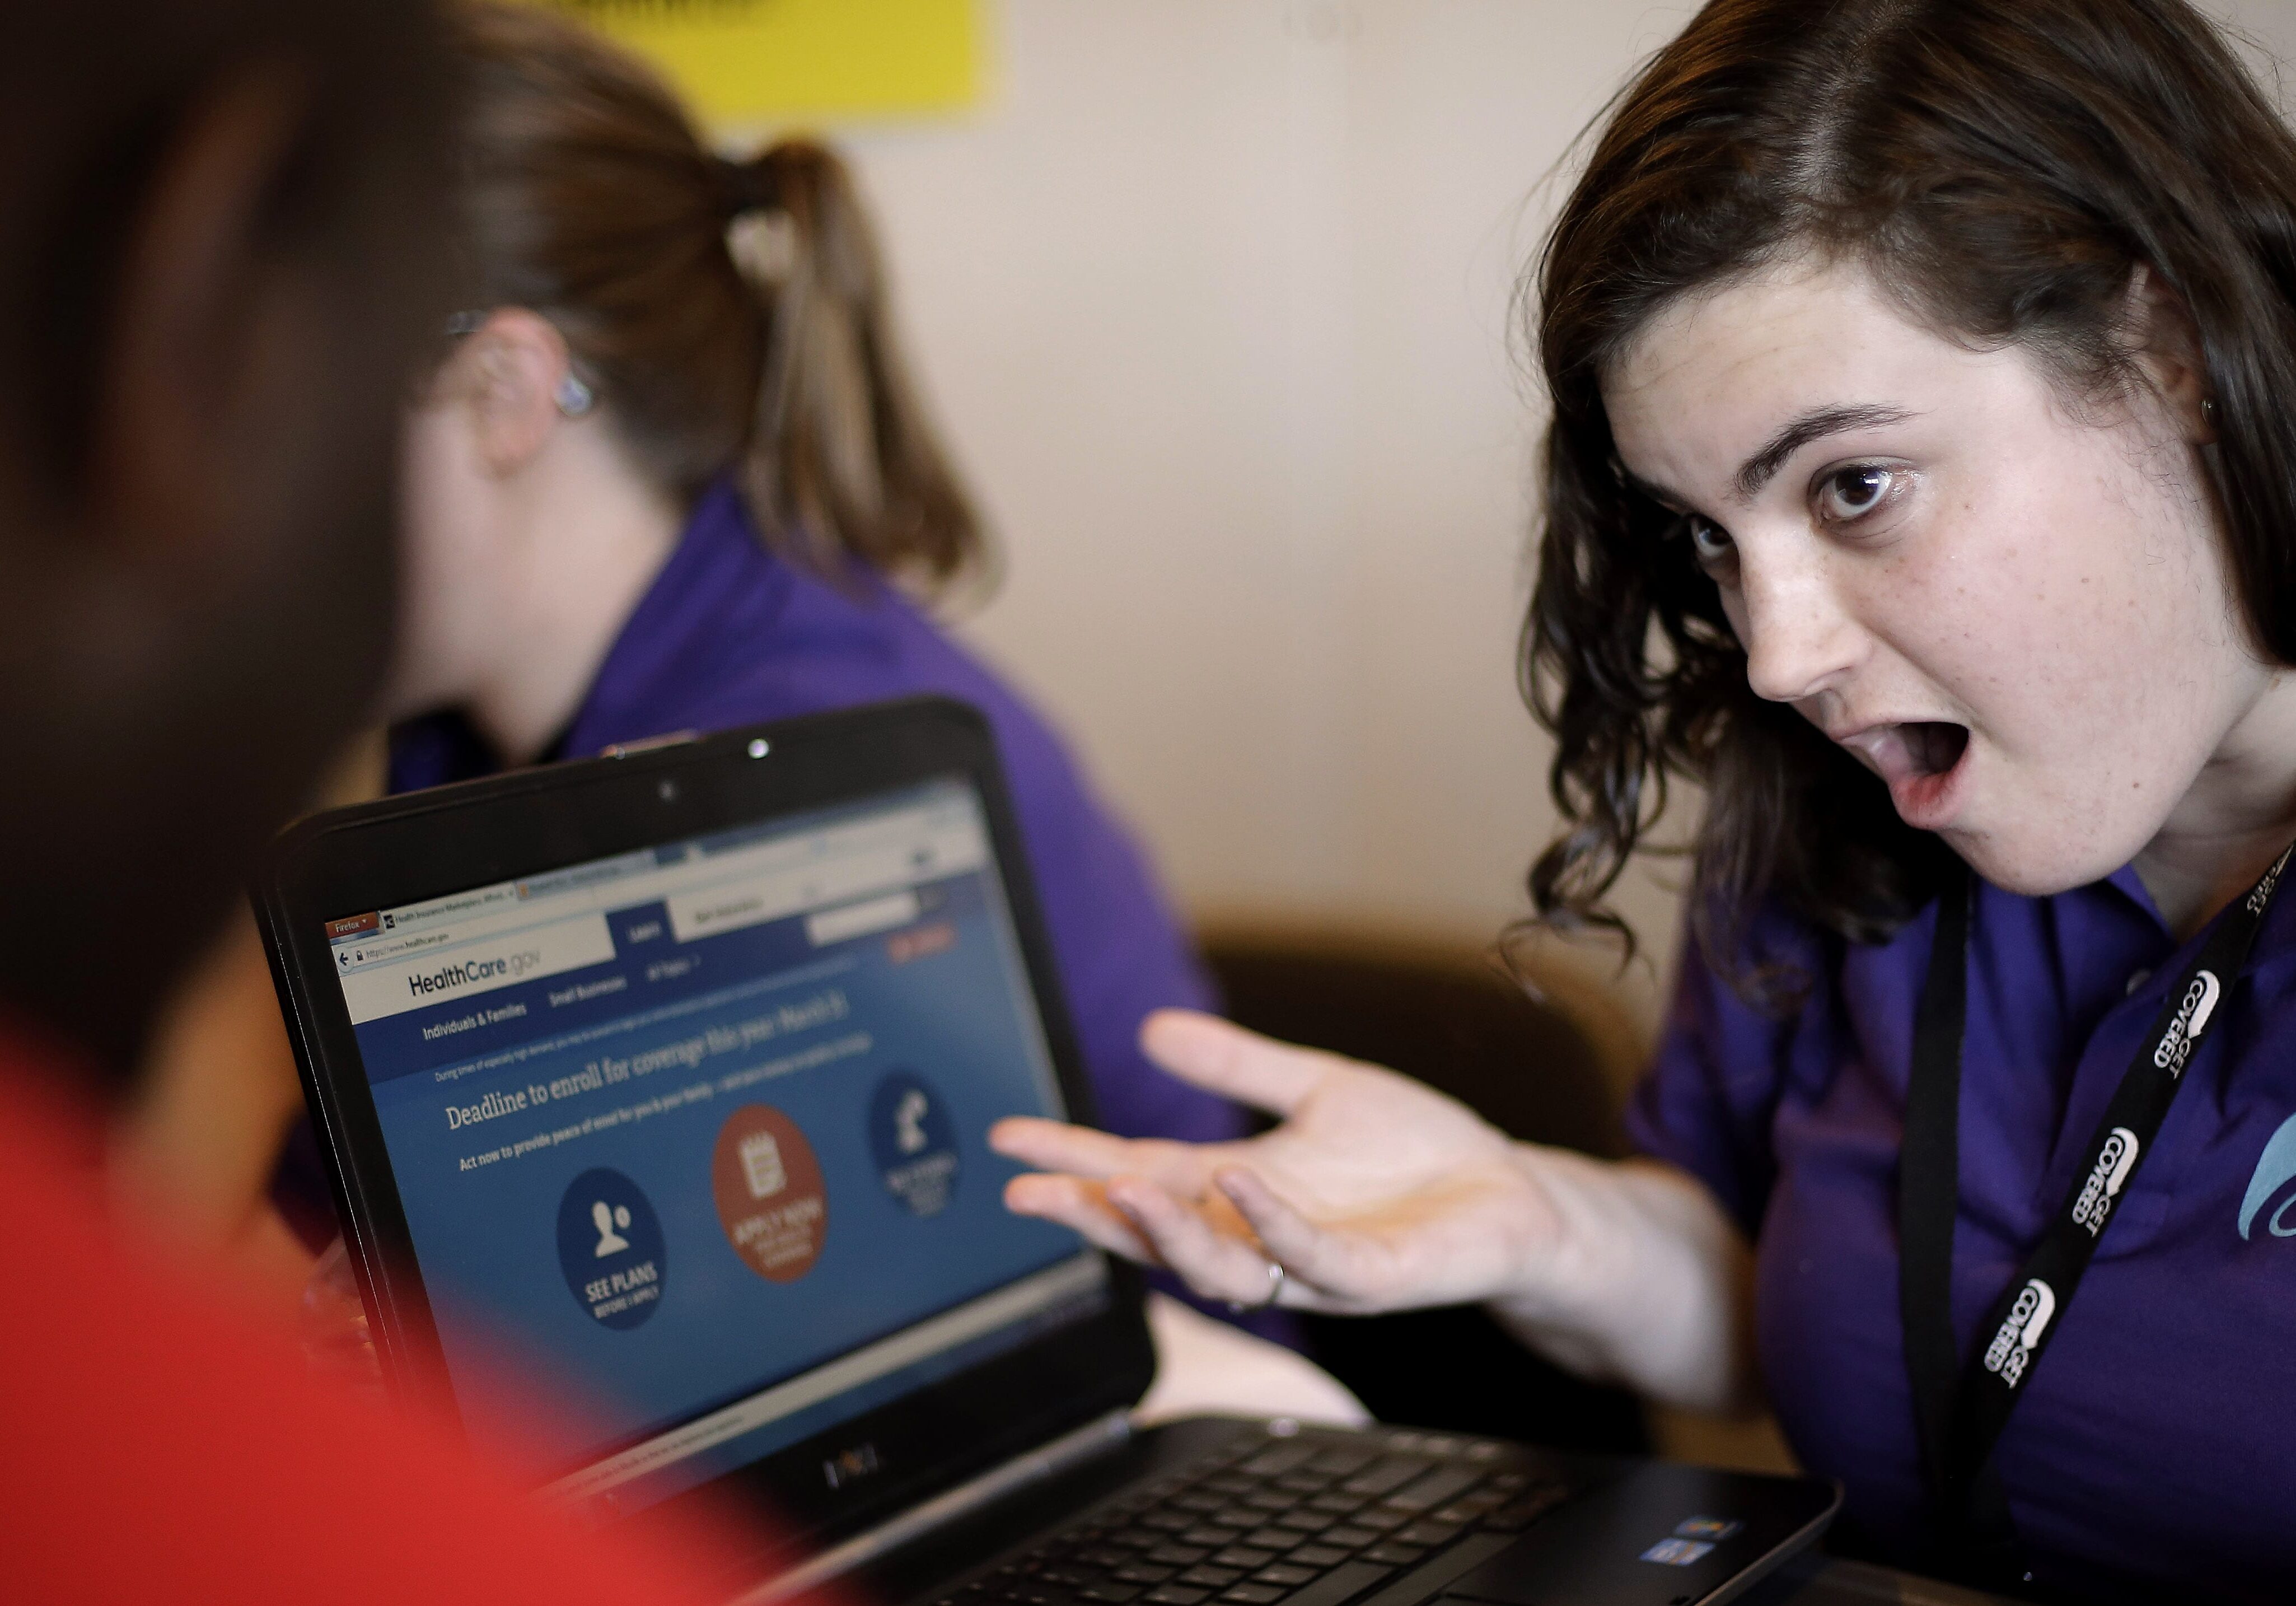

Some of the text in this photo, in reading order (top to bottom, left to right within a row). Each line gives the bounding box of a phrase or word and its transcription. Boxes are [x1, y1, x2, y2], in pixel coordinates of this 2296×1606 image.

[336, 921, 360, 933] Firefox
[423, 1003, 527, 1041] Individuals & Families
[2154, 979, 2205, 1068] COVERED
[2169, 1037, 2191, 1080] GET
[445, 1091, 528, 1130] Deadline
[527, 1084, 549, 1105] to
[550, 1061, 603, 1100] enroll
[602, 1057, 630, 1085] for
[632, 1036, 706, 1076] coverage
[459, 1156, 476, 1171] Act
[478, 1149, 501, 1166] now
[500, 1146, 513, 1159] to
[512, 1132, 551, 1158] provide
[552, 1124, 581, 1146] peace
[581, 1118, 593, 1135] of
[2072, 1136, 2124, 1225] COVERED
[2085, 1194, 2111, 1238] GET
[584, 1260, 658, 1303] SEE PLANS
[1984, 1287, 2039, 1372] COVERED
[2000, 1345, 2030, 1389] GET
